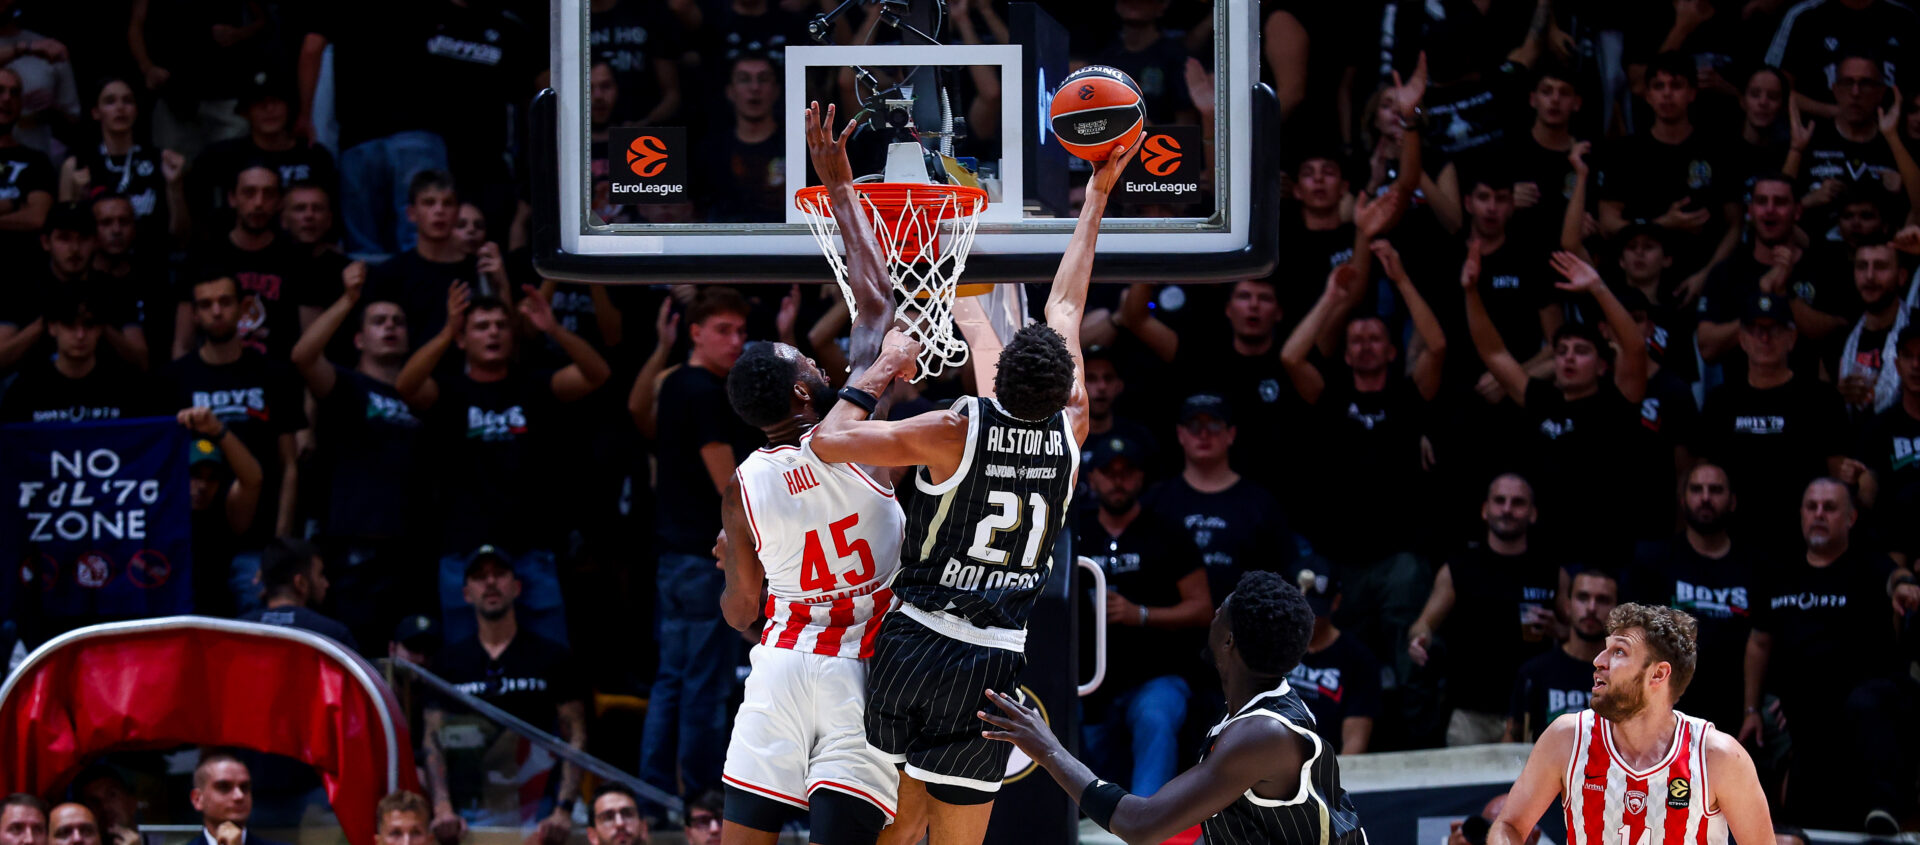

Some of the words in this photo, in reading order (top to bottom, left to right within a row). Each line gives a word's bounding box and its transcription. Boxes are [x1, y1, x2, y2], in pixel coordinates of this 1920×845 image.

[612, 182, 683, 196] EuroLeague
[1126, 181, 1198, 195] EuroLeague
[987, 425, 1043, 456] ALSTON
[1045, 430, 1064, 456] JR
[51, 448, 121, 479] NO
[1026, 467, 1057, 479] HOTELS
[783, 463, 820, 496] HALL
[26, 508, 147, 542] ZONE
[967, 490, 1050, 569] 21
[800, 512, 876, 592] 45
[1676, 580, 1749, 610] BOYS
[1290, 663, 1341, 692] OYS
